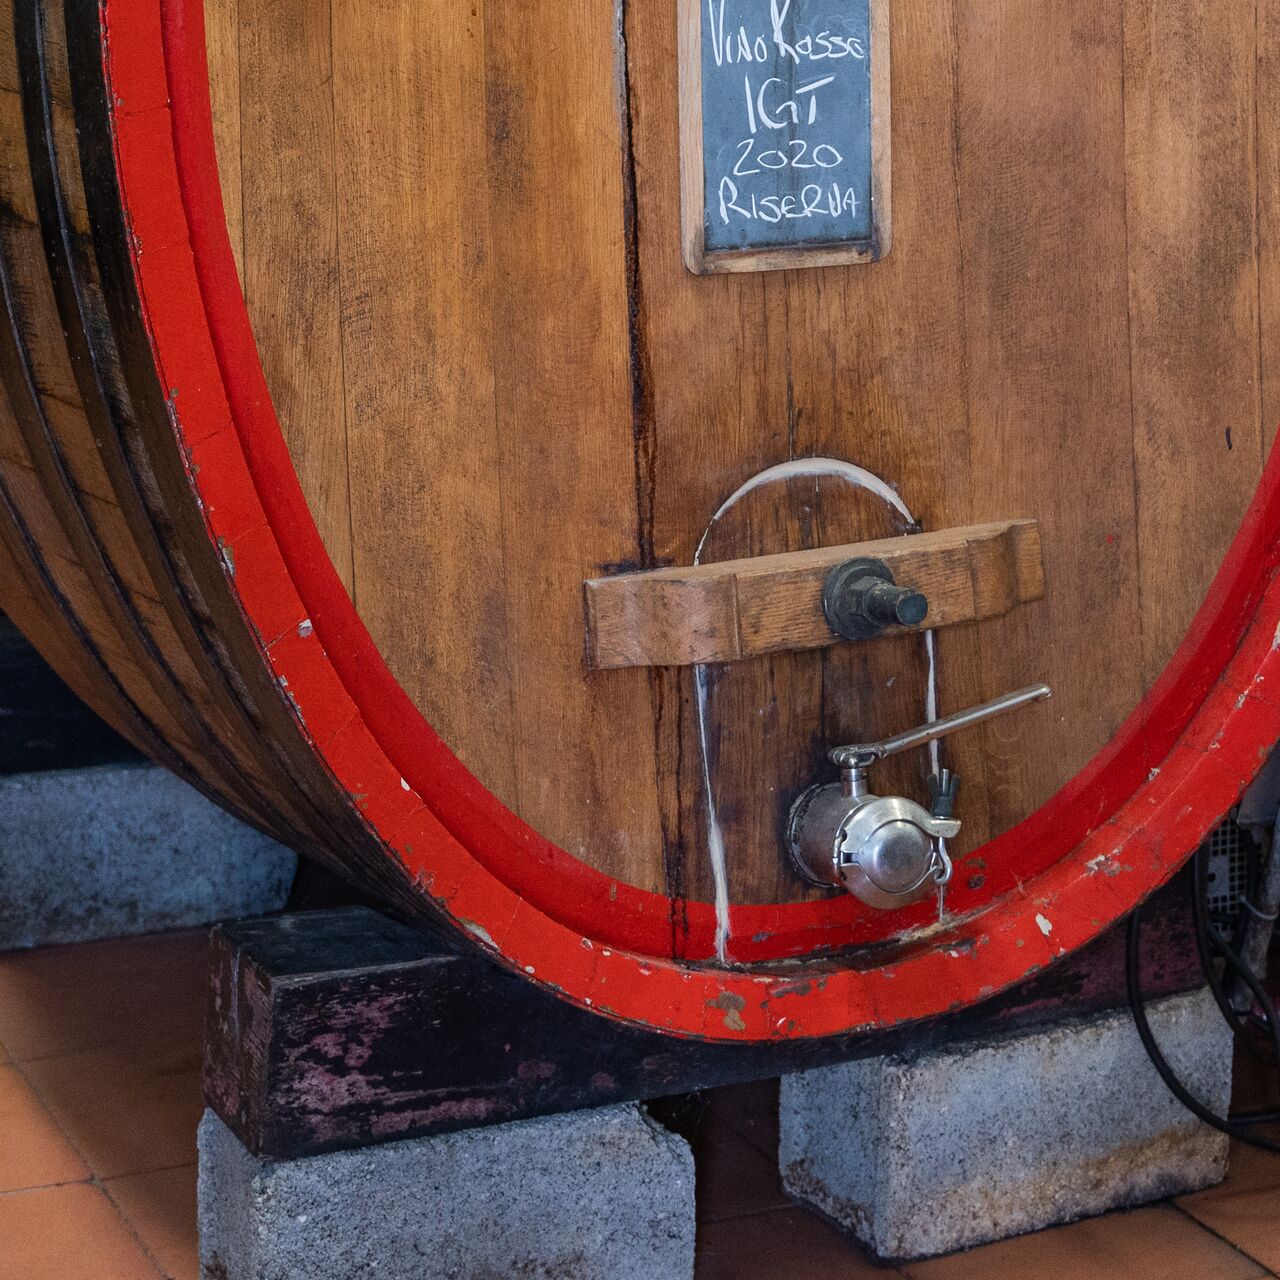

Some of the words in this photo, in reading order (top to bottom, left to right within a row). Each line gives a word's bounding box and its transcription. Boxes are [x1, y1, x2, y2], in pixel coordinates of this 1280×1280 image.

[744, 75, 835, 134] IGT
[733, 138, 843, 176] 2020
[718, 175, 862, 224] RISERVA
